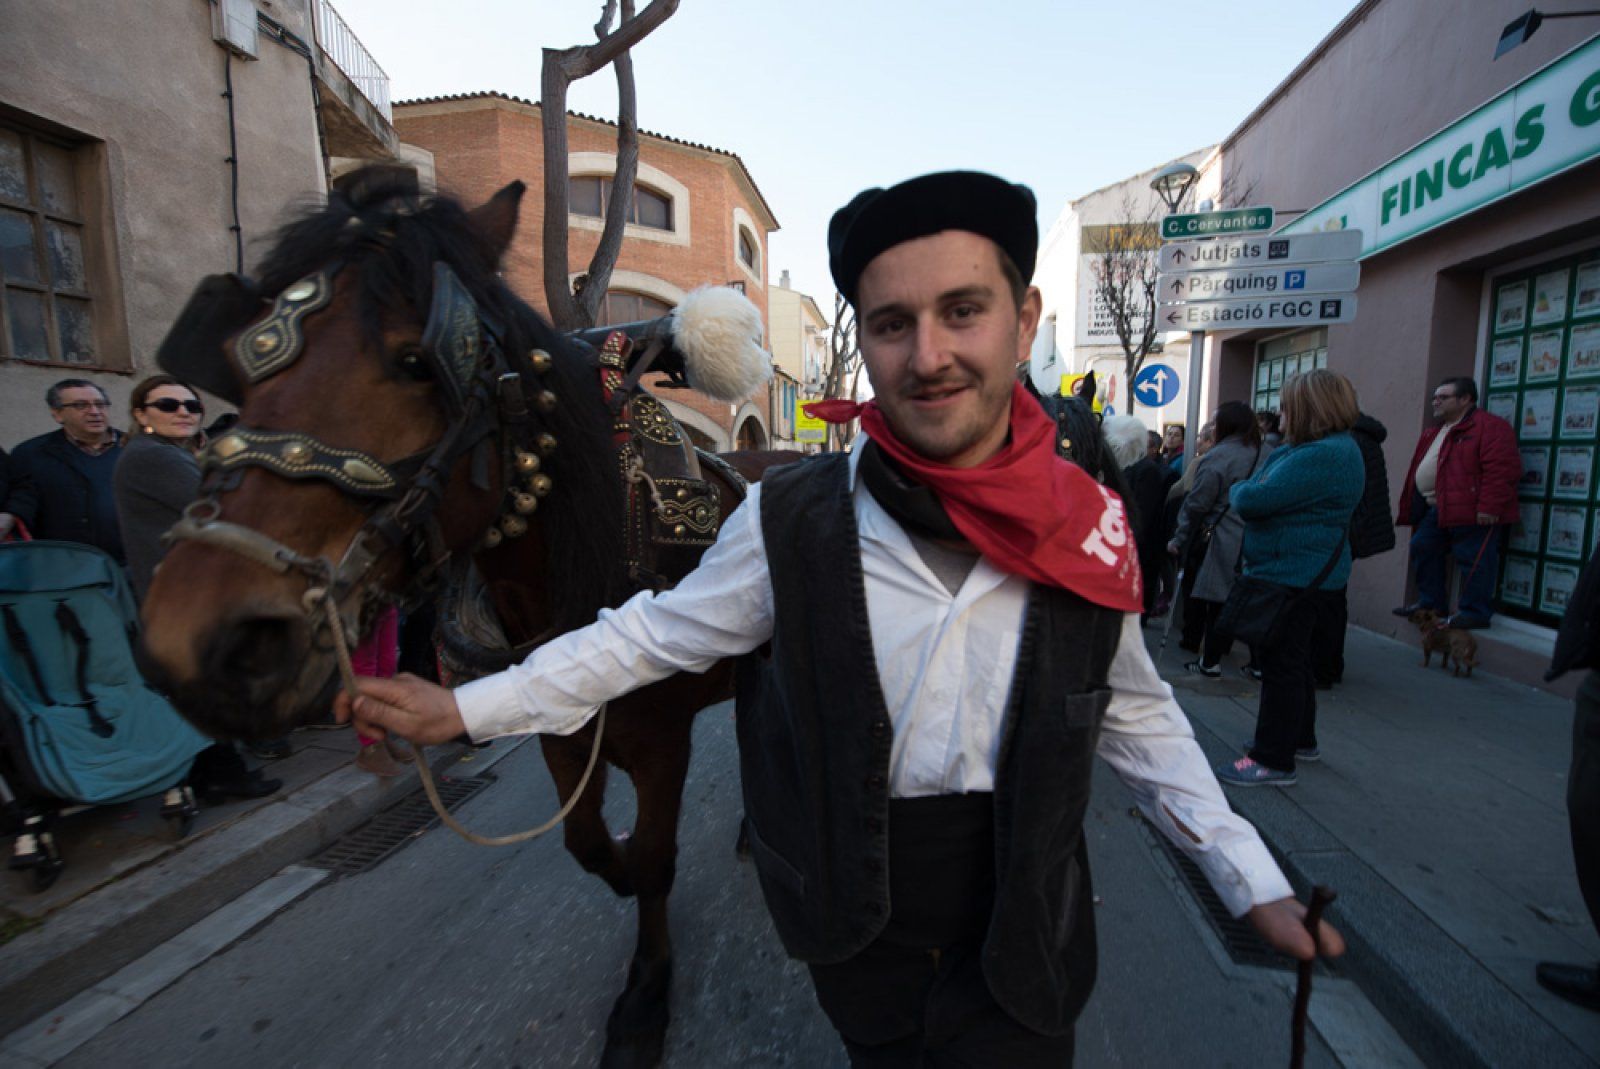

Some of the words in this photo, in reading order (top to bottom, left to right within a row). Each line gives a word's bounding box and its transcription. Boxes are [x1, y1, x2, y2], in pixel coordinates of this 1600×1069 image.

[1380, 103, 1545, 227] FINCAS
[1168, 220, 1184, 233] C.
[1186, 215, 1266, 231] Cervantes
[1190, 242, 1261, 262] Jutjats
[1186, 302, 1263, 322] Estació
[1269, 300, 1313, 319] FGC
